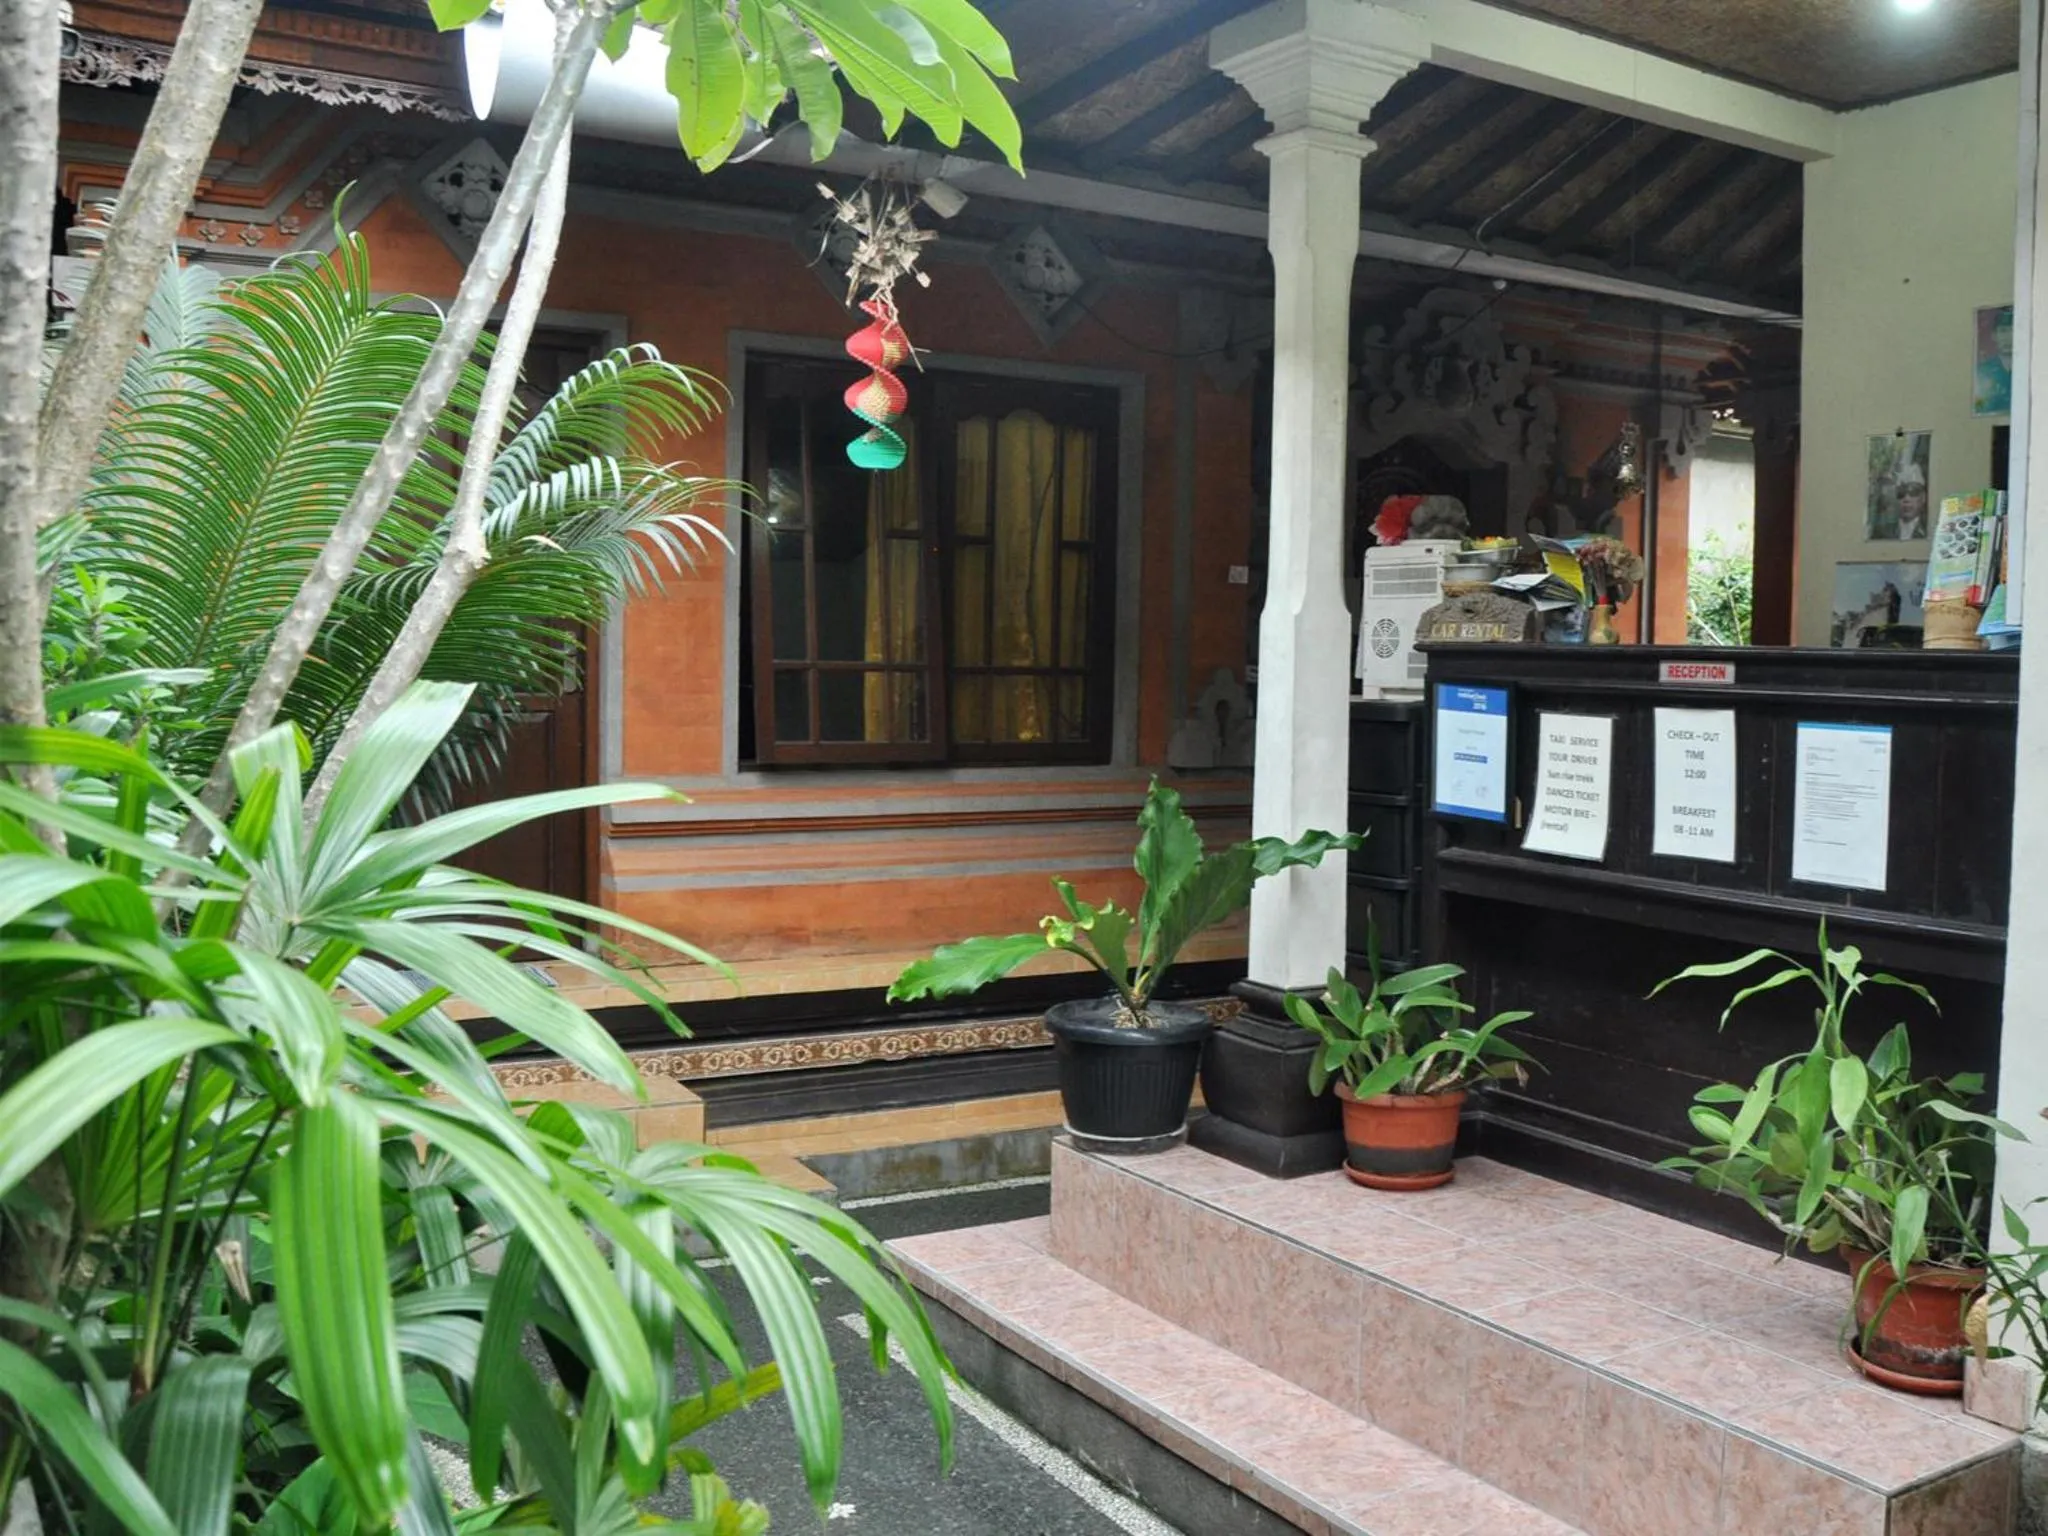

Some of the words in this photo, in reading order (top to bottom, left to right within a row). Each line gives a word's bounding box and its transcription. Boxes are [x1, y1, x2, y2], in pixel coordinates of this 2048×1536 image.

[1432, 623, 1457, 637] CAR
[1461, 623, 1506, 638] RENTAL
[1667, 665, 1726, 679] RECEPTION
[1667, 729, 1694, 740] CHECK
[1703, 732, 1720, 742] OUT
[1569, 736, 1599, 747] SERVICE
[1571, 754, 1598, 765] DRIVER
[1684, 750, 1704, 760] TIME
[1684, 769, 1706, 779] 12:00
[1575, 790, 1600, 801] TICKET
[1544, 804, 1572, 815] MOTOR
[1574, 808, 1590, 818] BIKE
[1699, 827, 1714, 837] AM
